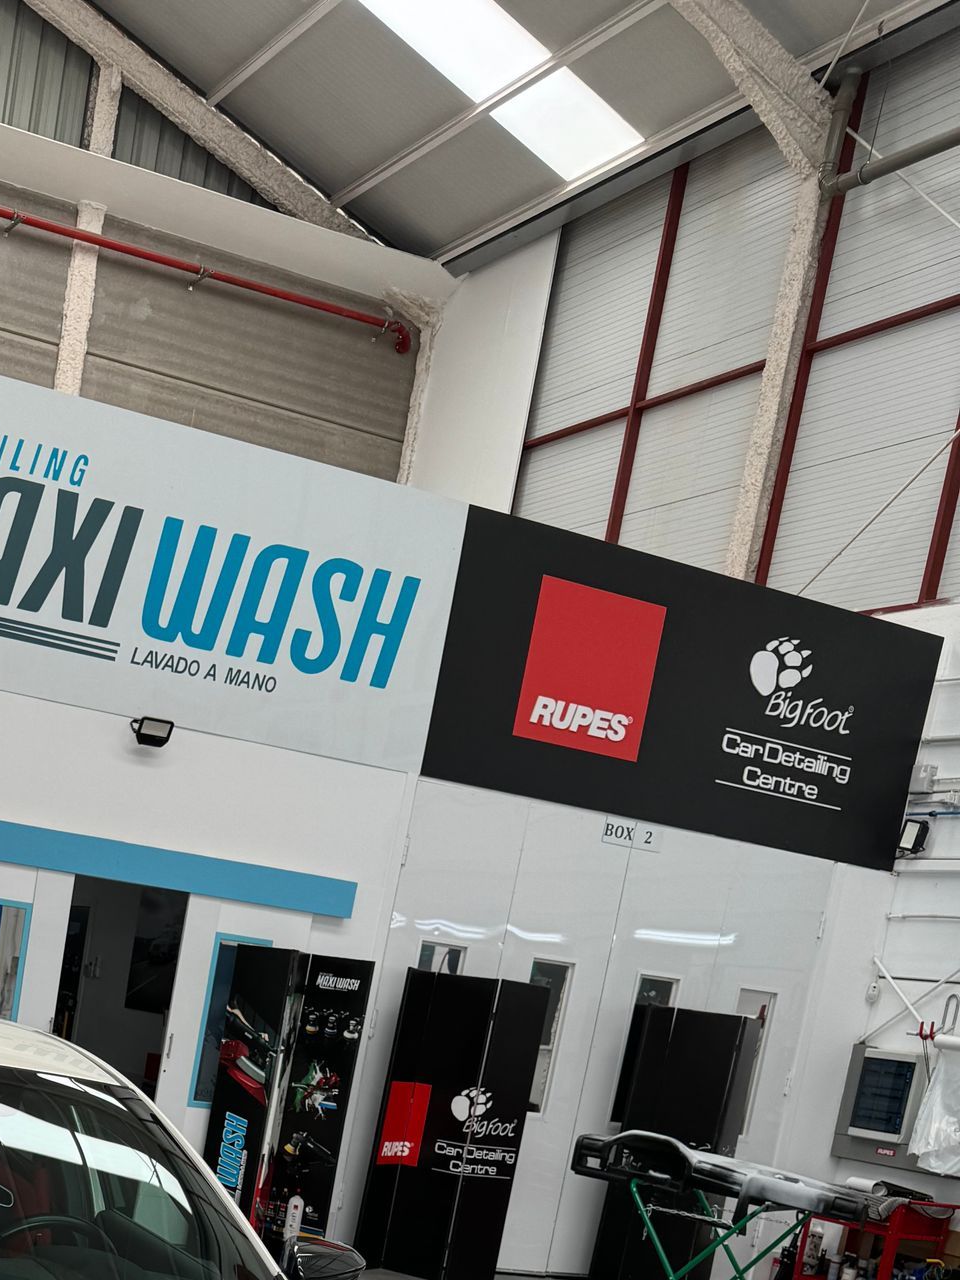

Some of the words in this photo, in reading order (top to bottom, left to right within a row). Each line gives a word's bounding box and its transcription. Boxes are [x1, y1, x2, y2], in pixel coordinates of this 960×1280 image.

[130, 647, 201, 677] LAVADO
[203, 663, 217, 682] A
[224, 667, 277, 693] MANO
[742, 765, 818, 800] Centre
[604, 823, 635, 841] BOX
[644, 830, 653, 844] 2
[217, 1111, 249, 1188] WASH
[449, 1160, 497, 1175] Centre
